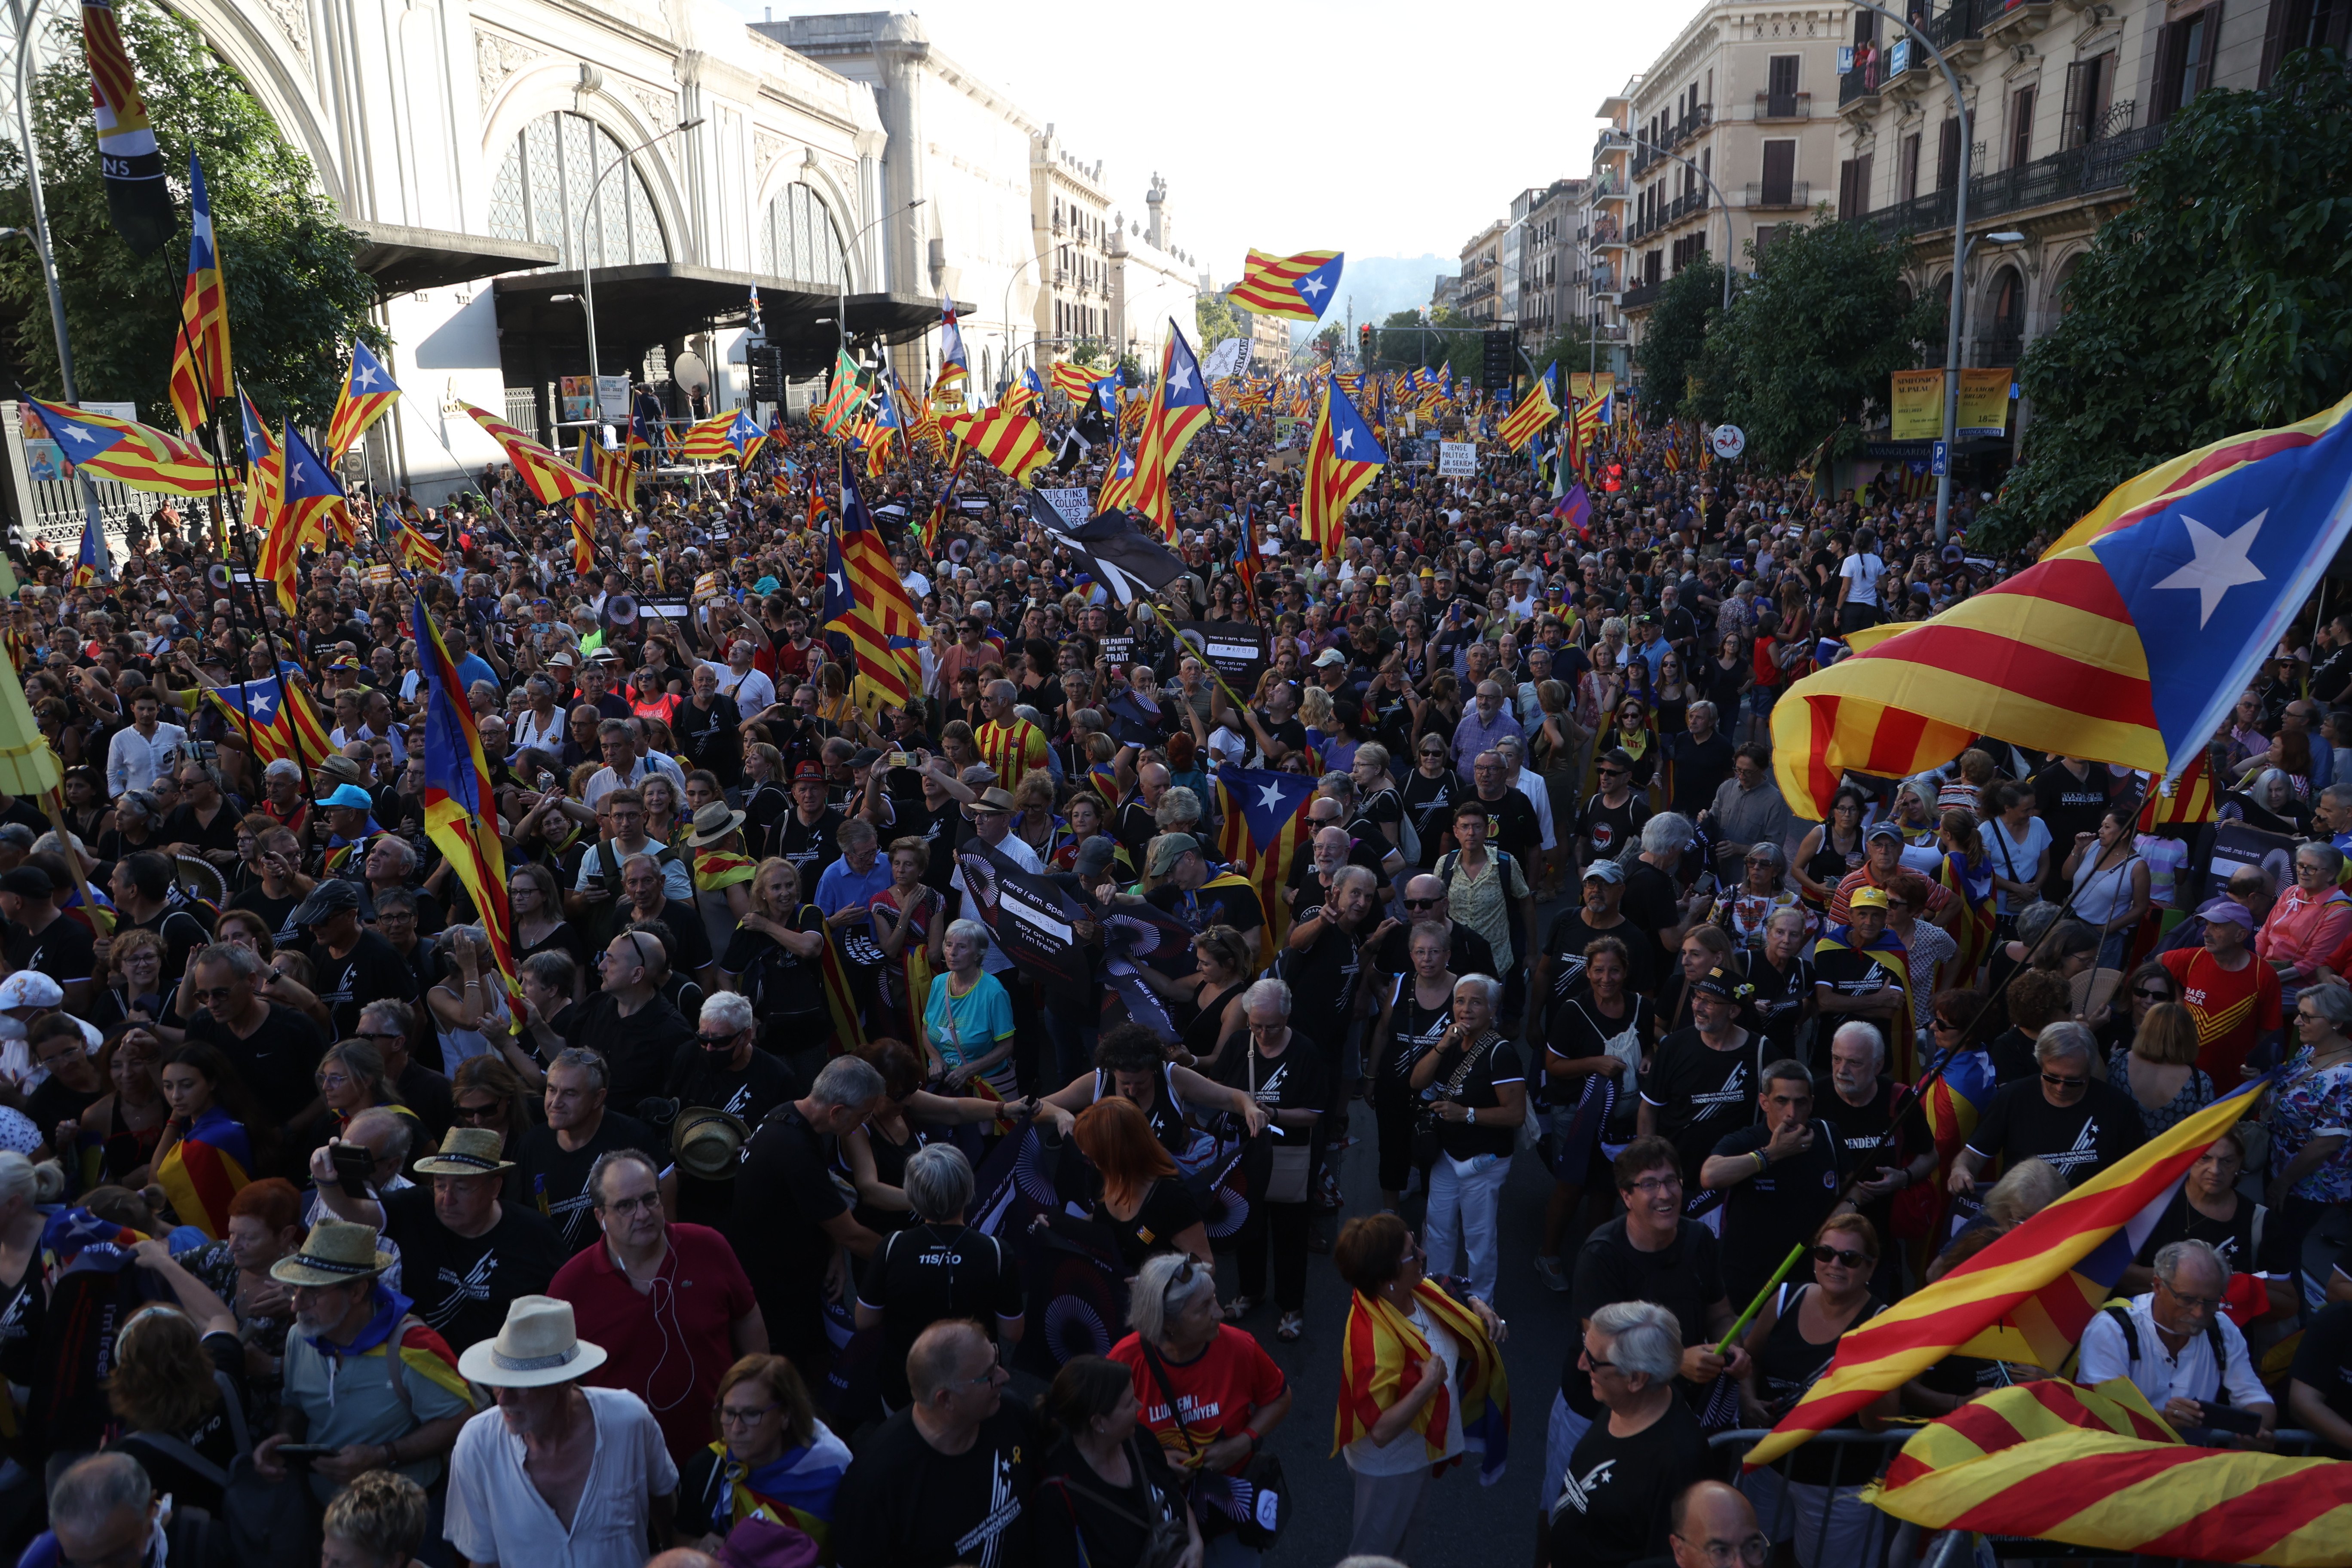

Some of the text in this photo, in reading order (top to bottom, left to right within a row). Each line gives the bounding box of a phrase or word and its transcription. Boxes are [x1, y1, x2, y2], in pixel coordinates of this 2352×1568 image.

[741, 379, 748, 391] DE
[735, 397, 750, 409] FRAN
[1936, 446, 1943, 459] P
[1064, 489, 1083, 498] FINS
[1055, 499, 1087, 508] COLLONS
[1062, 508, 1081, 517] OTS
[1105, 651, 1129, 662] TRAÏT
[984, 752, 1015, 763] QATR
[1002, 879, 1023, 895] Here
[1027, 893, 1044, 907] am,
[272, 932, 299, 943] ENDÈNCIA
[1015, 920, 1062, 952] Spy on me,
[845, 928, 860, 959] PARTITS
[853, 938, 872, 960] ENS HEU
[1021, 932, 1056, 956] I'm free!
[1561, 956, 1587, 965] INDEPEND
[2195, 989, 2206, 999] ÉS
[1691, 1094, 1745, 1104] INDEPENDÈNCIA
[2043, 1154, 2098, 1164] NDEPENDÈNCIA
[919, 1251, 962, 1268] 11S/10
[97, 1303, 118, 1379] I'm free!
[1148, 1394, 1192, 1424] LLUEM
[1180, 1401, 1220, 1426] UANYEM
